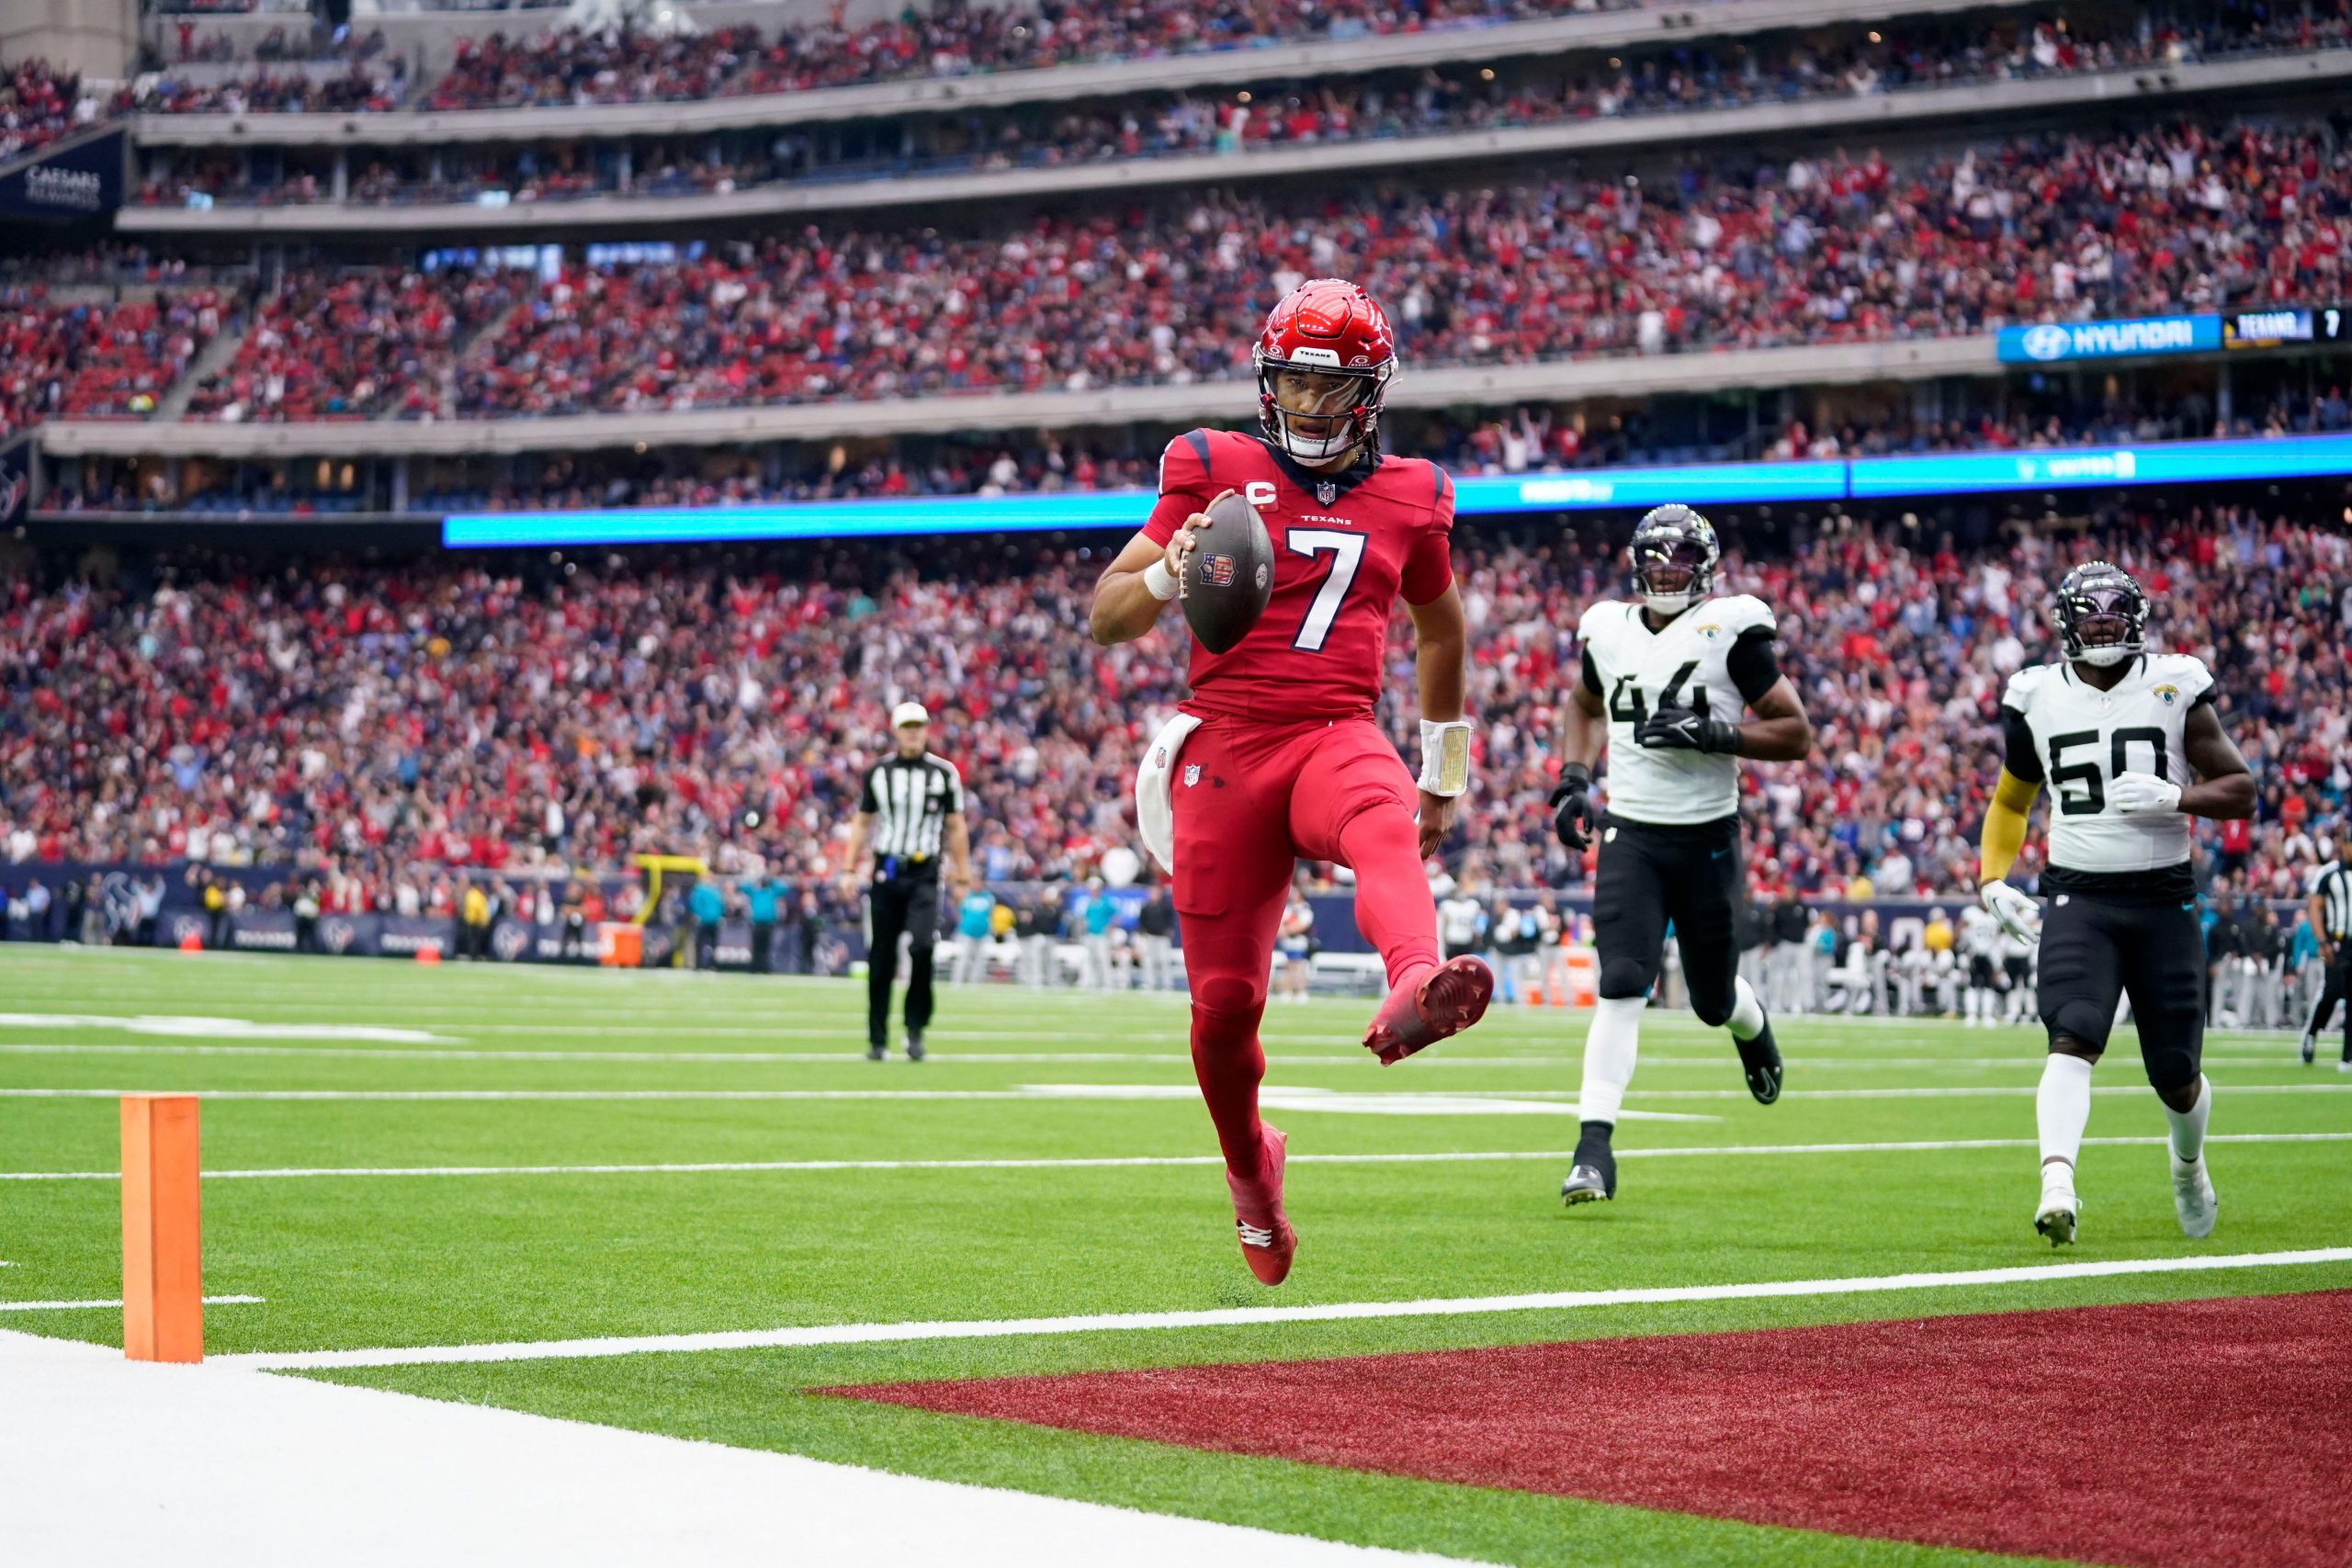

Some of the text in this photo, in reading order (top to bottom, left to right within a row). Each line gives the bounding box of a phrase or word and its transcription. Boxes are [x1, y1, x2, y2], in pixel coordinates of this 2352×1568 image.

[26, 165, 101, 188] CAESARS
[2074, 320, 2193, 353] HYUNDAI
[1246, 481, 1276, 504] C
[1301, 515, 1352, 525] TEXANS
[1215, 558, 1233, 583] NFL
[1284, 526, 1369, 654] 7
[2049, 727, 2168, 816] 50
